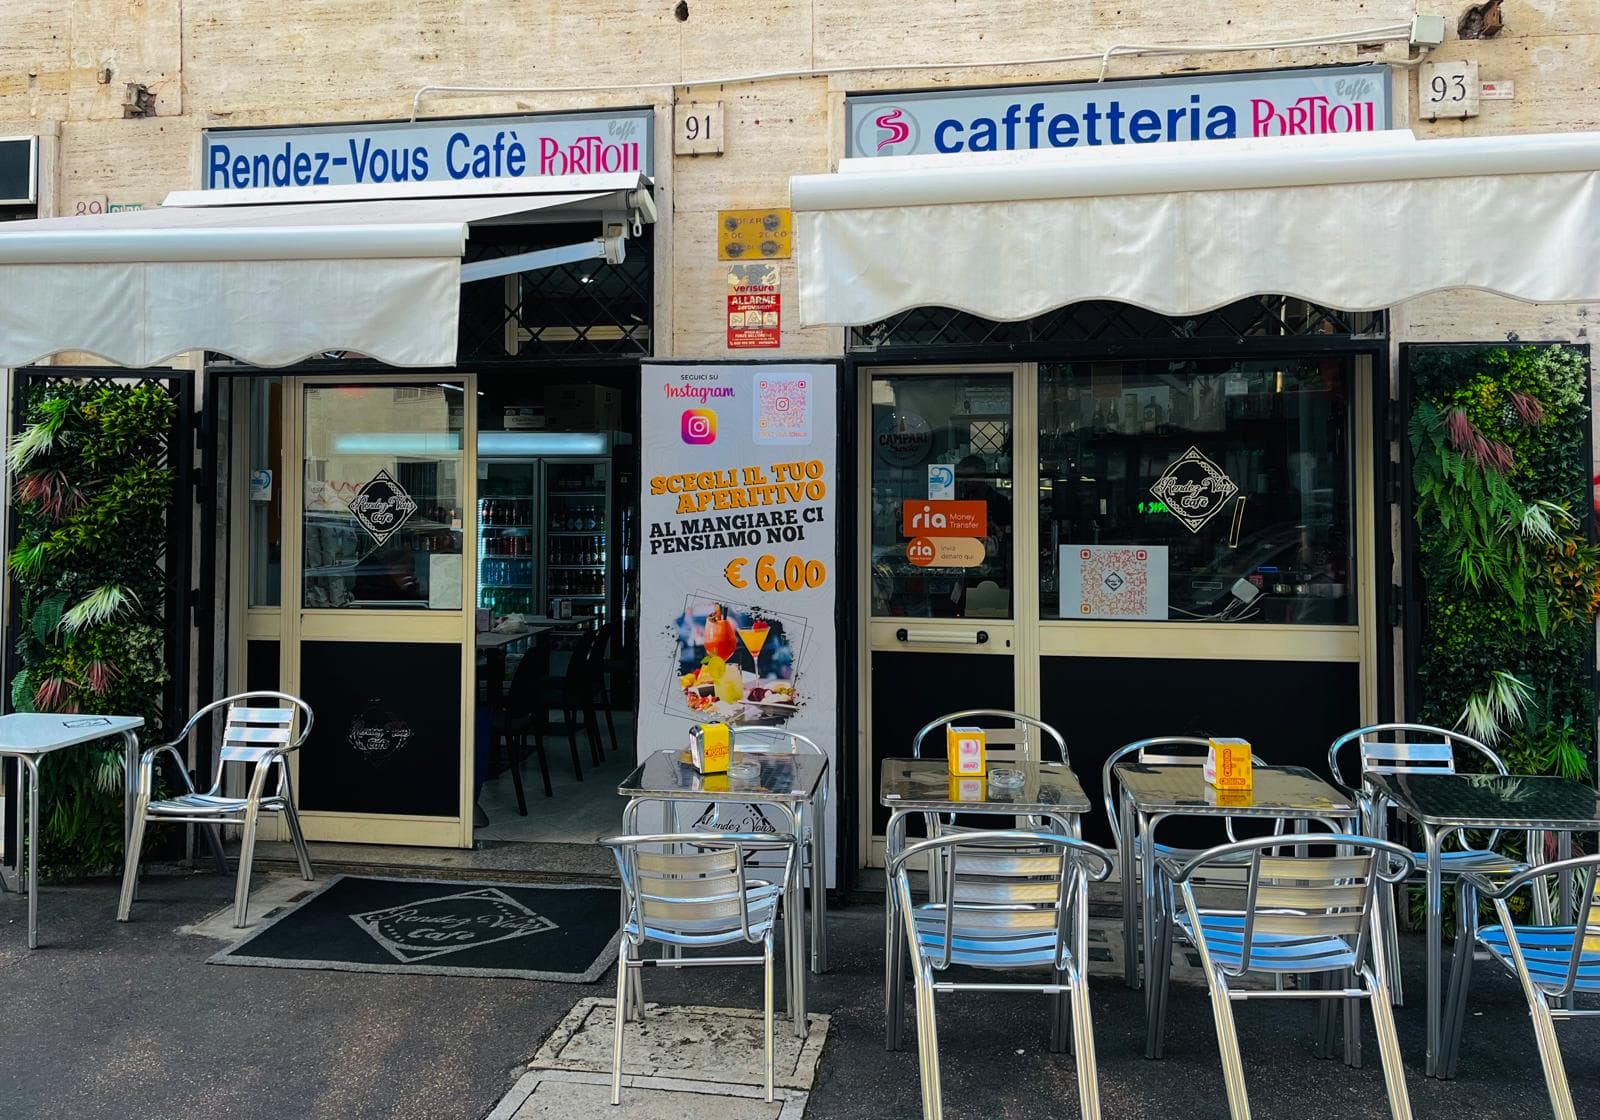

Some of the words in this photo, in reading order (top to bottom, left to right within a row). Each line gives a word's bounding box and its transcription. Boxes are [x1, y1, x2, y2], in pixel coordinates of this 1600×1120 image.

[1431, 75, 1466, 102] 93
[686, 115, 710, 140] 91
[934, 94, 1237, 153] caffetteria
[210, 138, 429, 189] Rendez-Vous
[446, 131, 526, 180] Cafè
[731, 295, 777, 306] ALLARME
[733, 284, 775, 292] verisure
[663, 383, 736, 404] Instagram
[879, 432, 928, 445] CAMPARI
[650, 468, 738, 495] SCEGLI
[743, 466, 767, 485] IL
[771, 460, 824, 482] TUO
[676, 480, 827, 514] APERITIVO
[649, 522, 677, 538] AL
[681, 509, 798, 535] MANGIARE
[802, 507, 824, 523] CI
[912, 505, 947, 528] ria
[949, 513, 975, 521] Money
[650, 529, 761, 555] PENSIAMO
[767, 525, 805, 544] NOI
[909, 541, 932, 556] ria
[723, 557, 749, 589] €
[755, 554, 827, 592] 6.00
